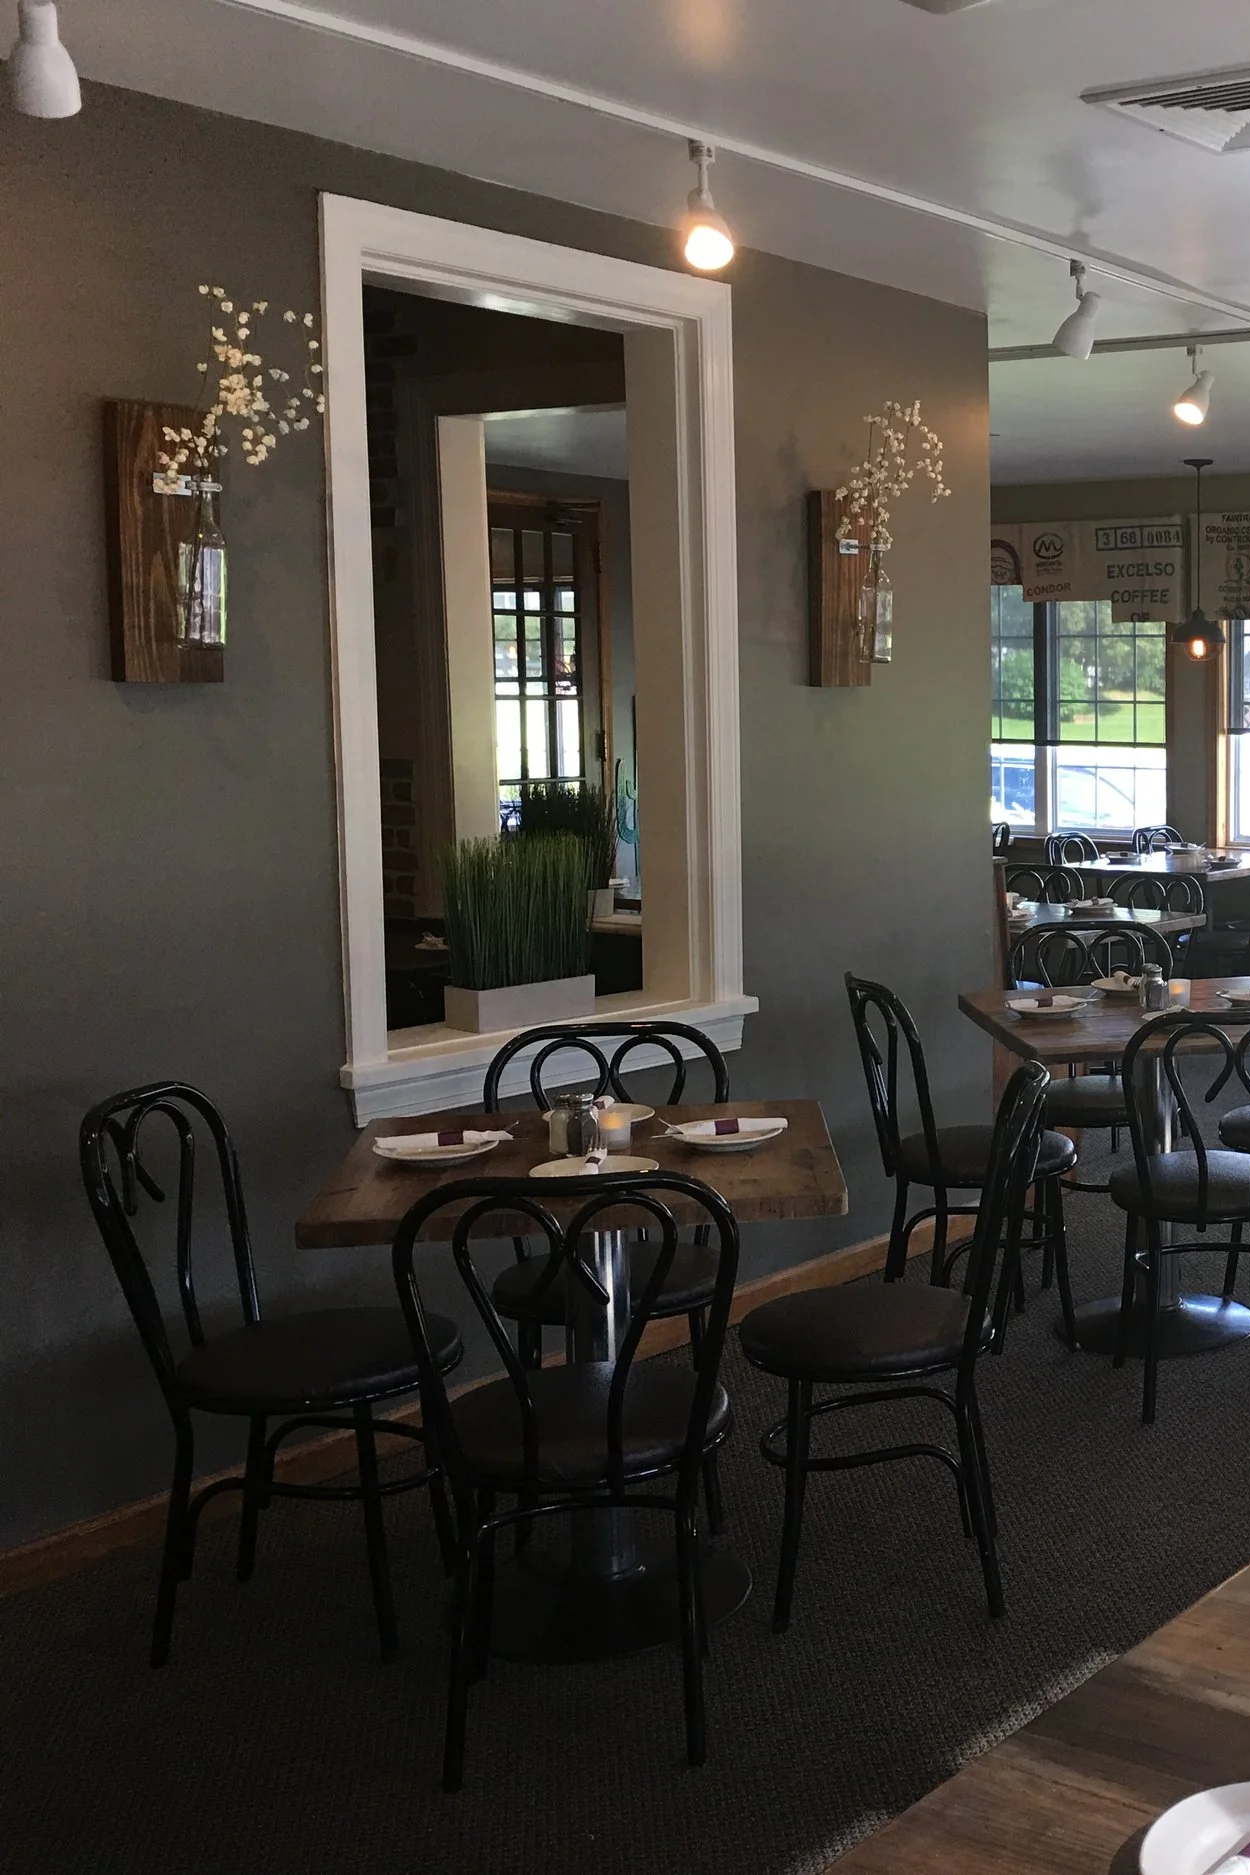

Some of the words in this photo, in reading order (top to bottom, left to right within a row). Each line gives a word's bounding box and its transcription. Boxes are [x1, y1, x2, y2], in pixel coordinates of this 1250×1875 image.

[1102, 532, 1110, 546] 3
[1120, 531, 1138, 545] 68
[1147, 528, 1181, 545] 0084
[1205, 526, 1240, 536] ORGANIC
[1107, 561, 1175, 579] EXCELSO
[1111, 588, 1170, 604] COFFEE
